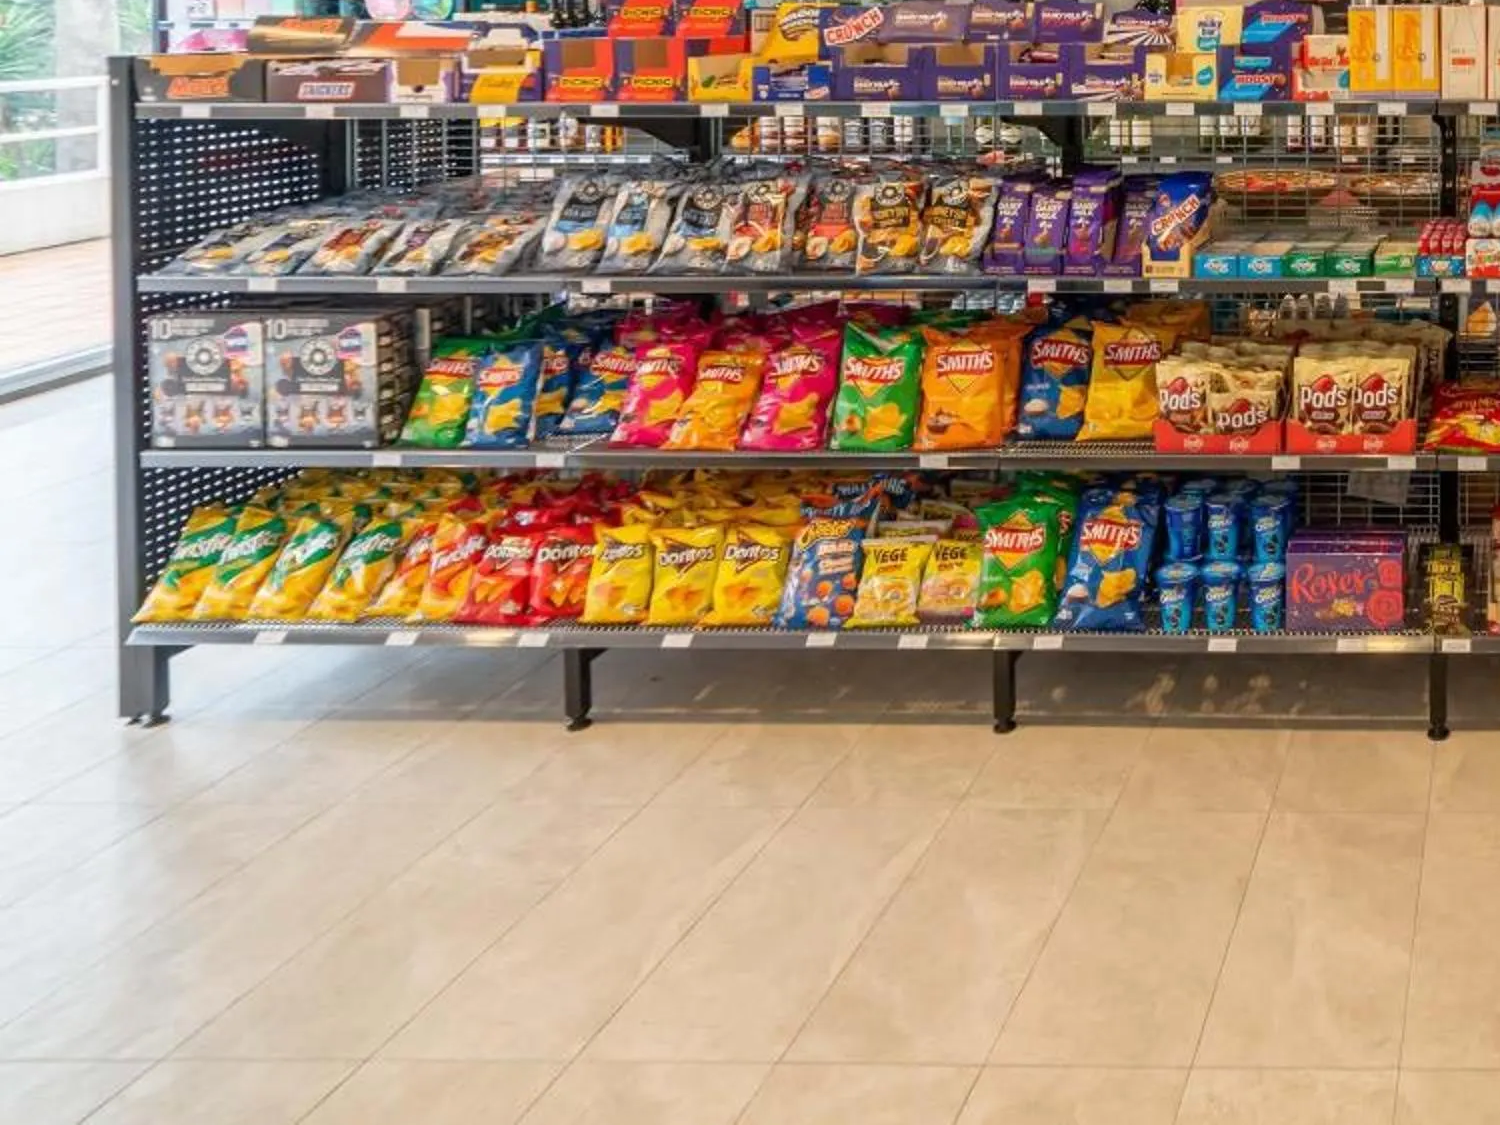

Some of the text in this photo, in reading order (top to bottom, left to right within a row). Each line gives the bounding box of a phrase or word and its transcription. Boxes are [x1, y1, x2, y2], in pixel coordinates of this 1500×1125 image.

[1301, 385, 1347, 409] Pods
[1354, 383, 1398, 408] Pods
[1218, 407, 1267, 429] Pods
[659, 546, 715, 565] Doritos
[725, 544, 779, 561] Doritos
[873, 547, 908, 563] VEGE
[934, 546, 967, 560] VEGE
